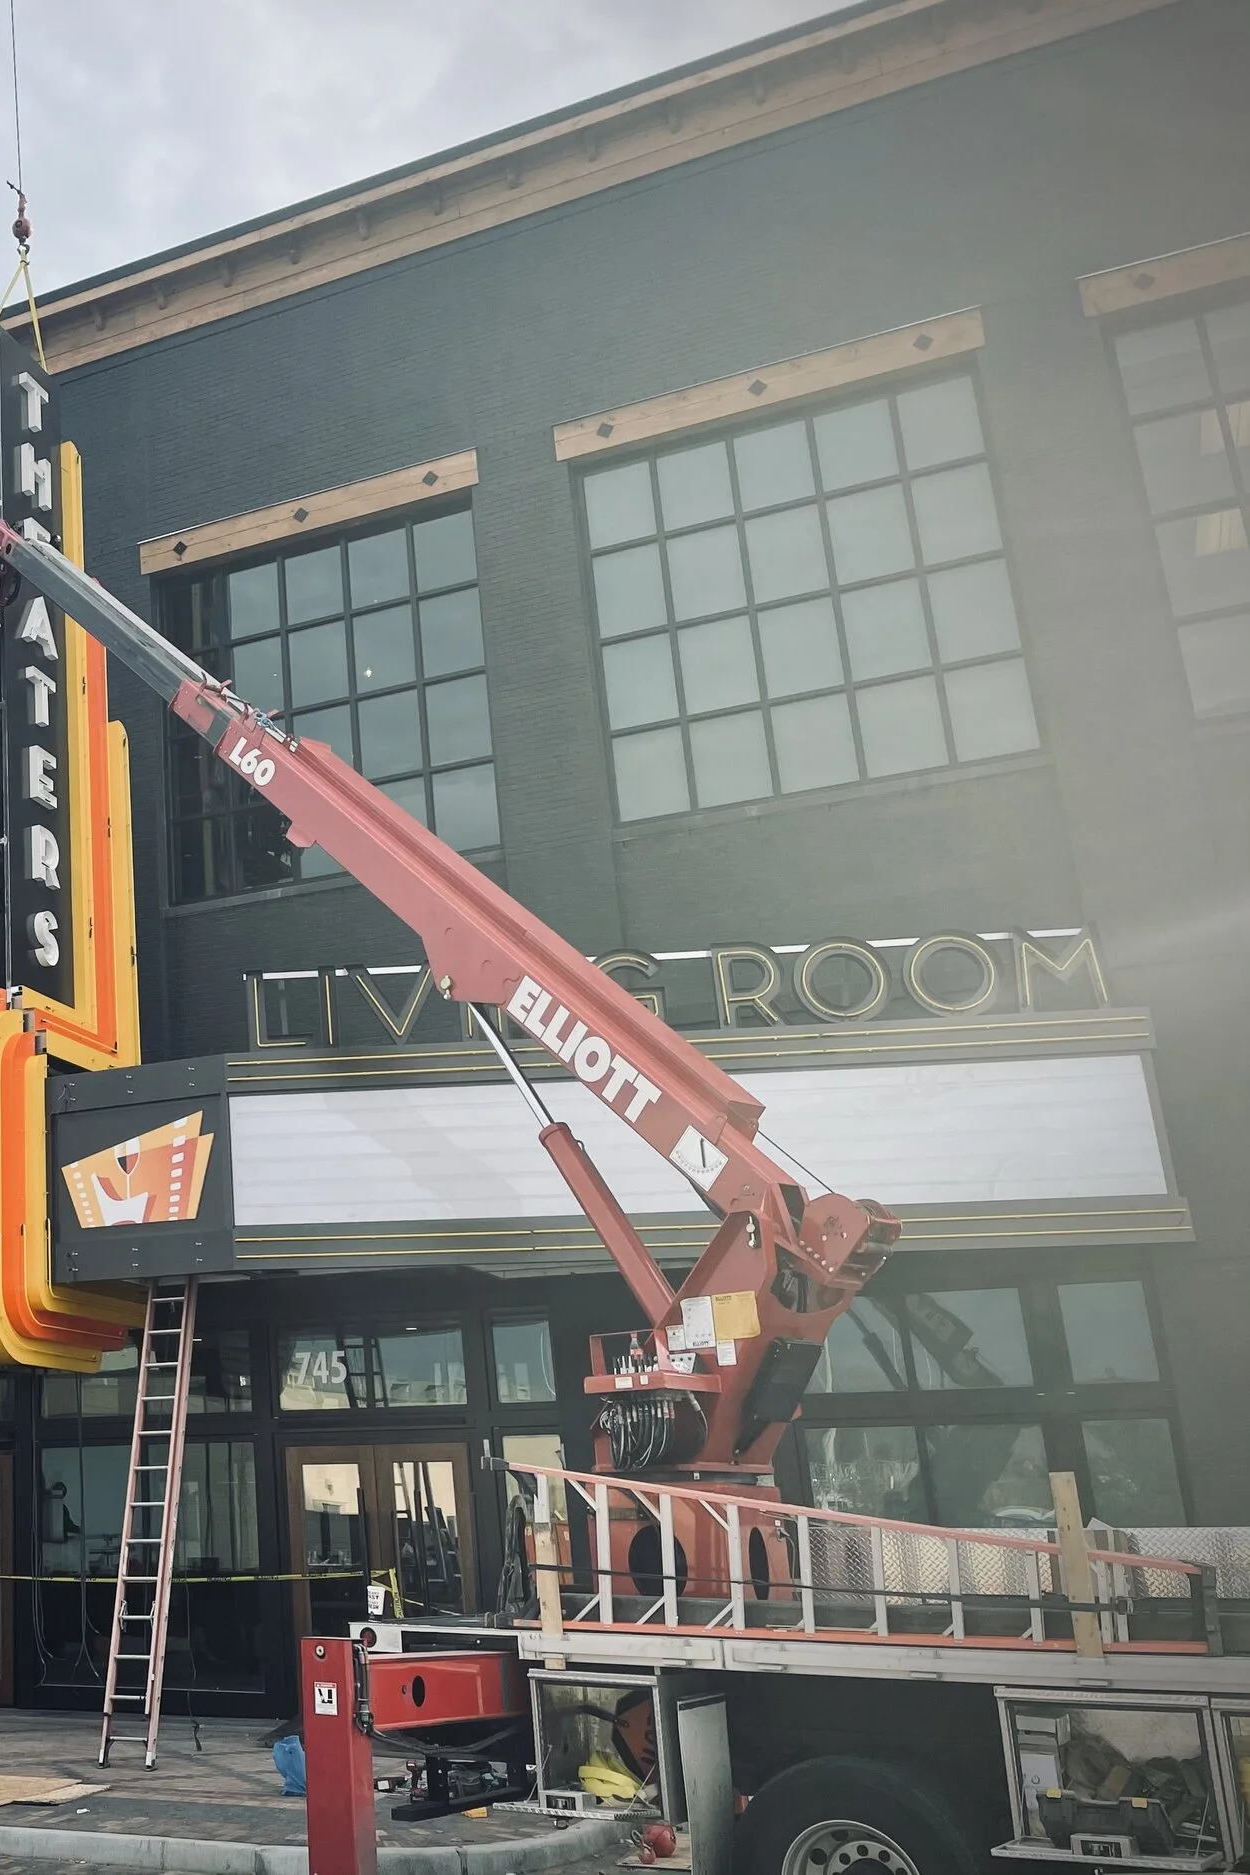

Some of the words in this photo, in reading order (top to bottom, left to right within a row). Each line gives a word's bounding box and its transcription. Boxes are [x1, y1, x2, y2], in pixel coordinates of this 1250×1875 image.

[228, 737, 276, 786] L60
[712, 921, 1112, 1029] ROOM
[506, 976, 662, 1123] ELLIOTT
[295, 1351, 346, 1385] 745
